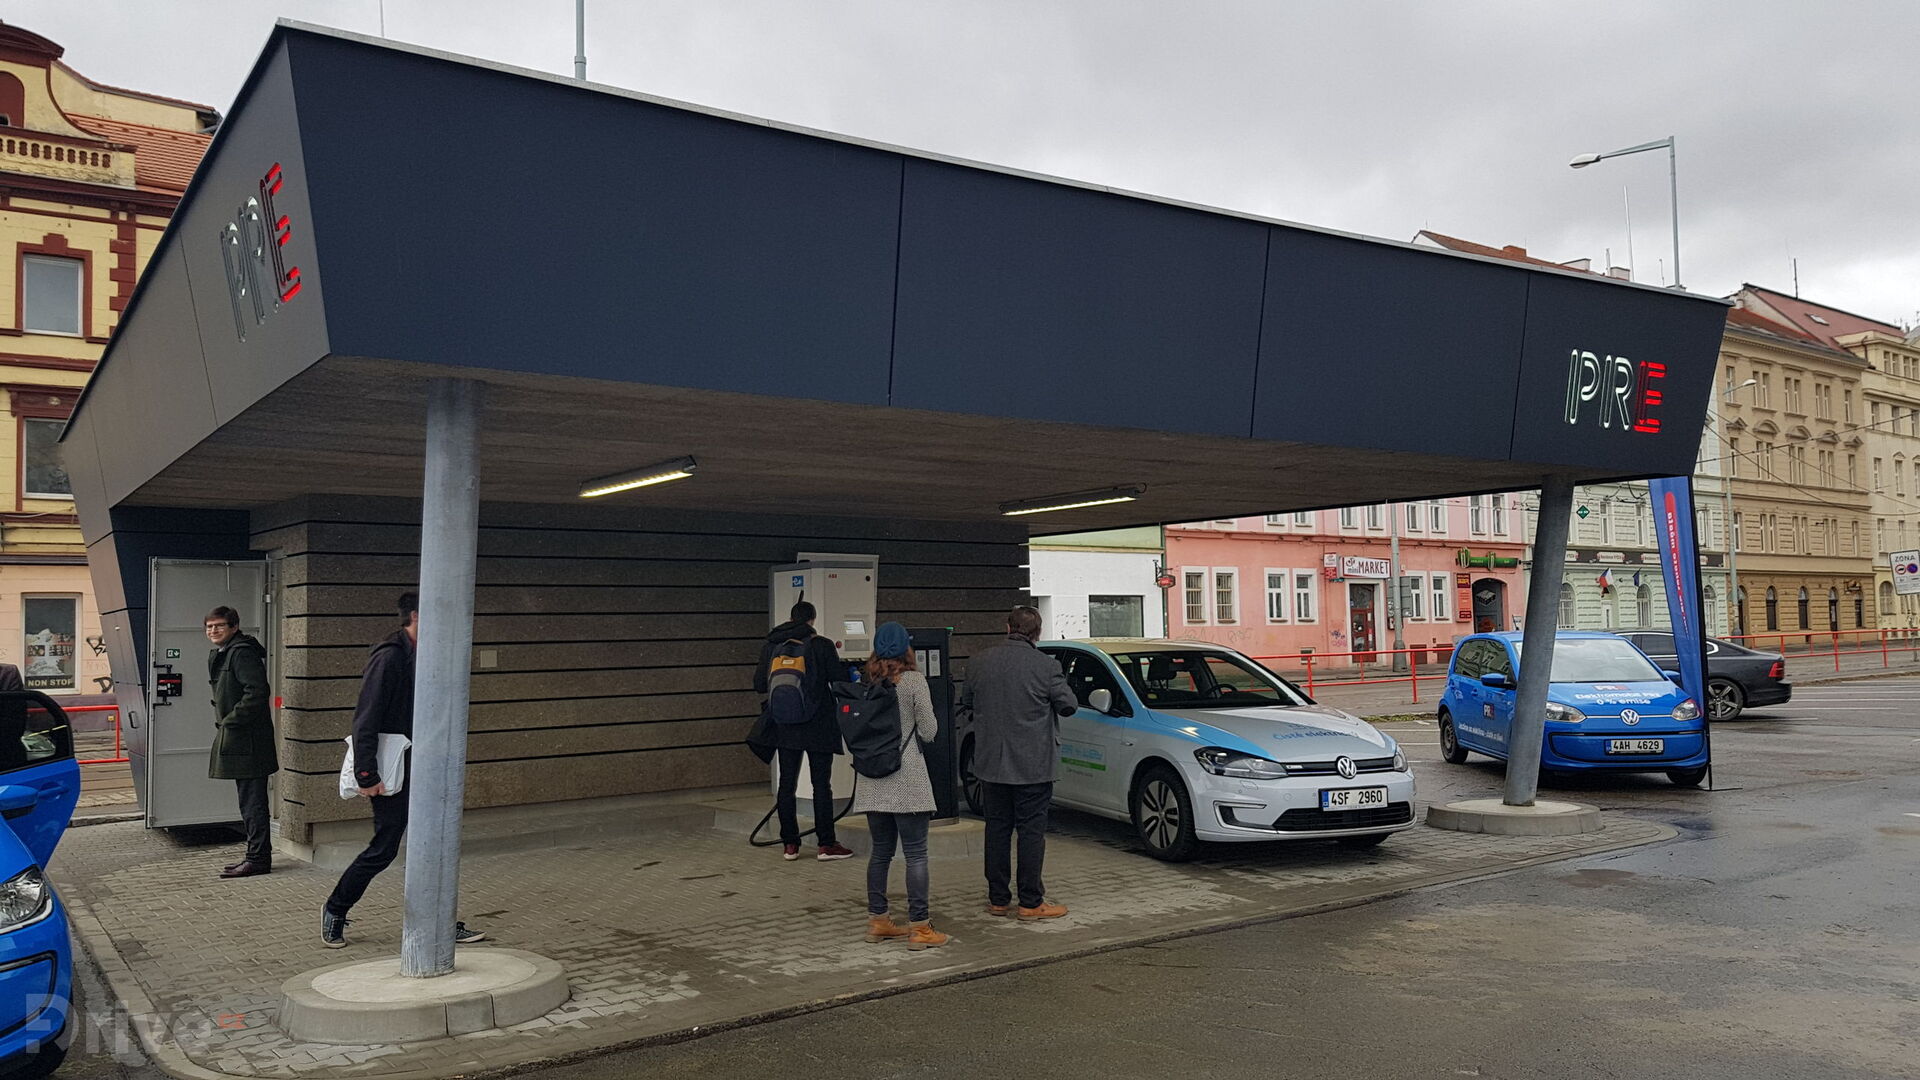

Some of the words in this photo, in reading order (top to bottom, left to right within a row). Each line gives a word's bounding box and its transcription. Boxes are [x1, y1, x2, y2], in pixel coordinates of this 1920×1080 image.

[1564, 348, 1667, 434] PRE
[1358, 560, 1390, 575] MARKET
[27, 679, 48, 687] NON
[1613, 741, 1631, 750] 4AH
[1637, 741, 1660, 750] 4629
[1331, 792, 1350, 805] 4SF
[1358, 790, 1383, 804] 2960
